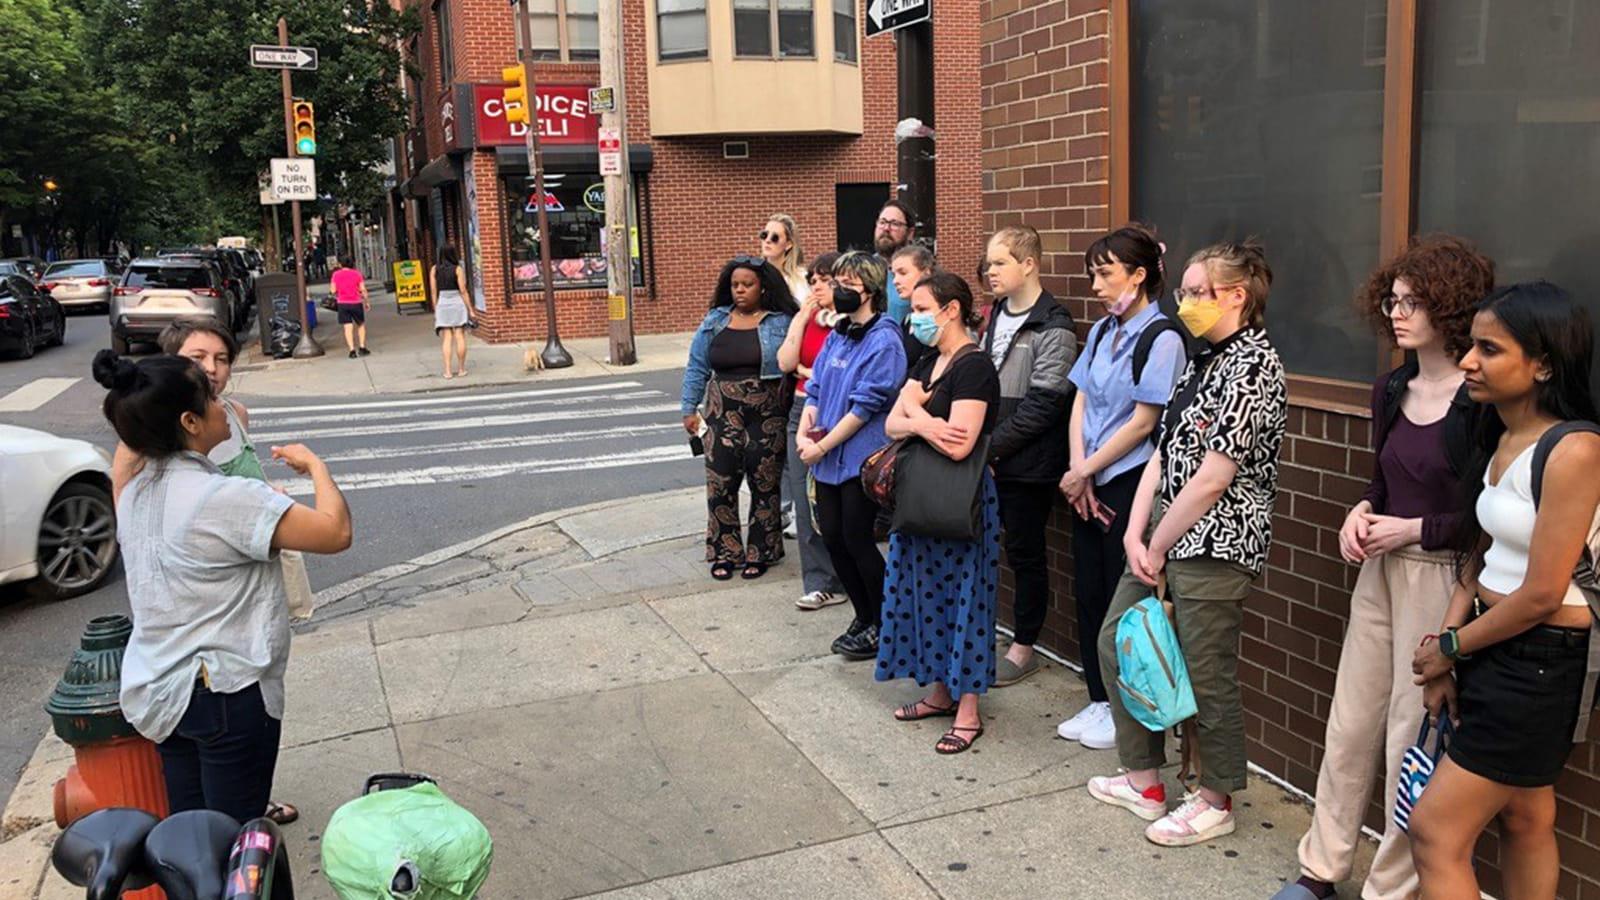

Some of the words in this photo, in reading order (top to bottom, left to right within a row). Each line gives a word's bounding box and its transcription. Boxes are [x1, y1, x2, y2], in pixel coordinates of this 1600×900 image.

[881, 0, 898, 15] ONE
[258, 52, 277, 61] ONE
[280, 53, 297, 61] WAY
[483, 94, 588, 119] CICE
[286, 164, 300, 172] NO
[281, 174, 307, 183] TURN
[277, 185, 291, 194] ON
[293, 185, 312, 193] RED
